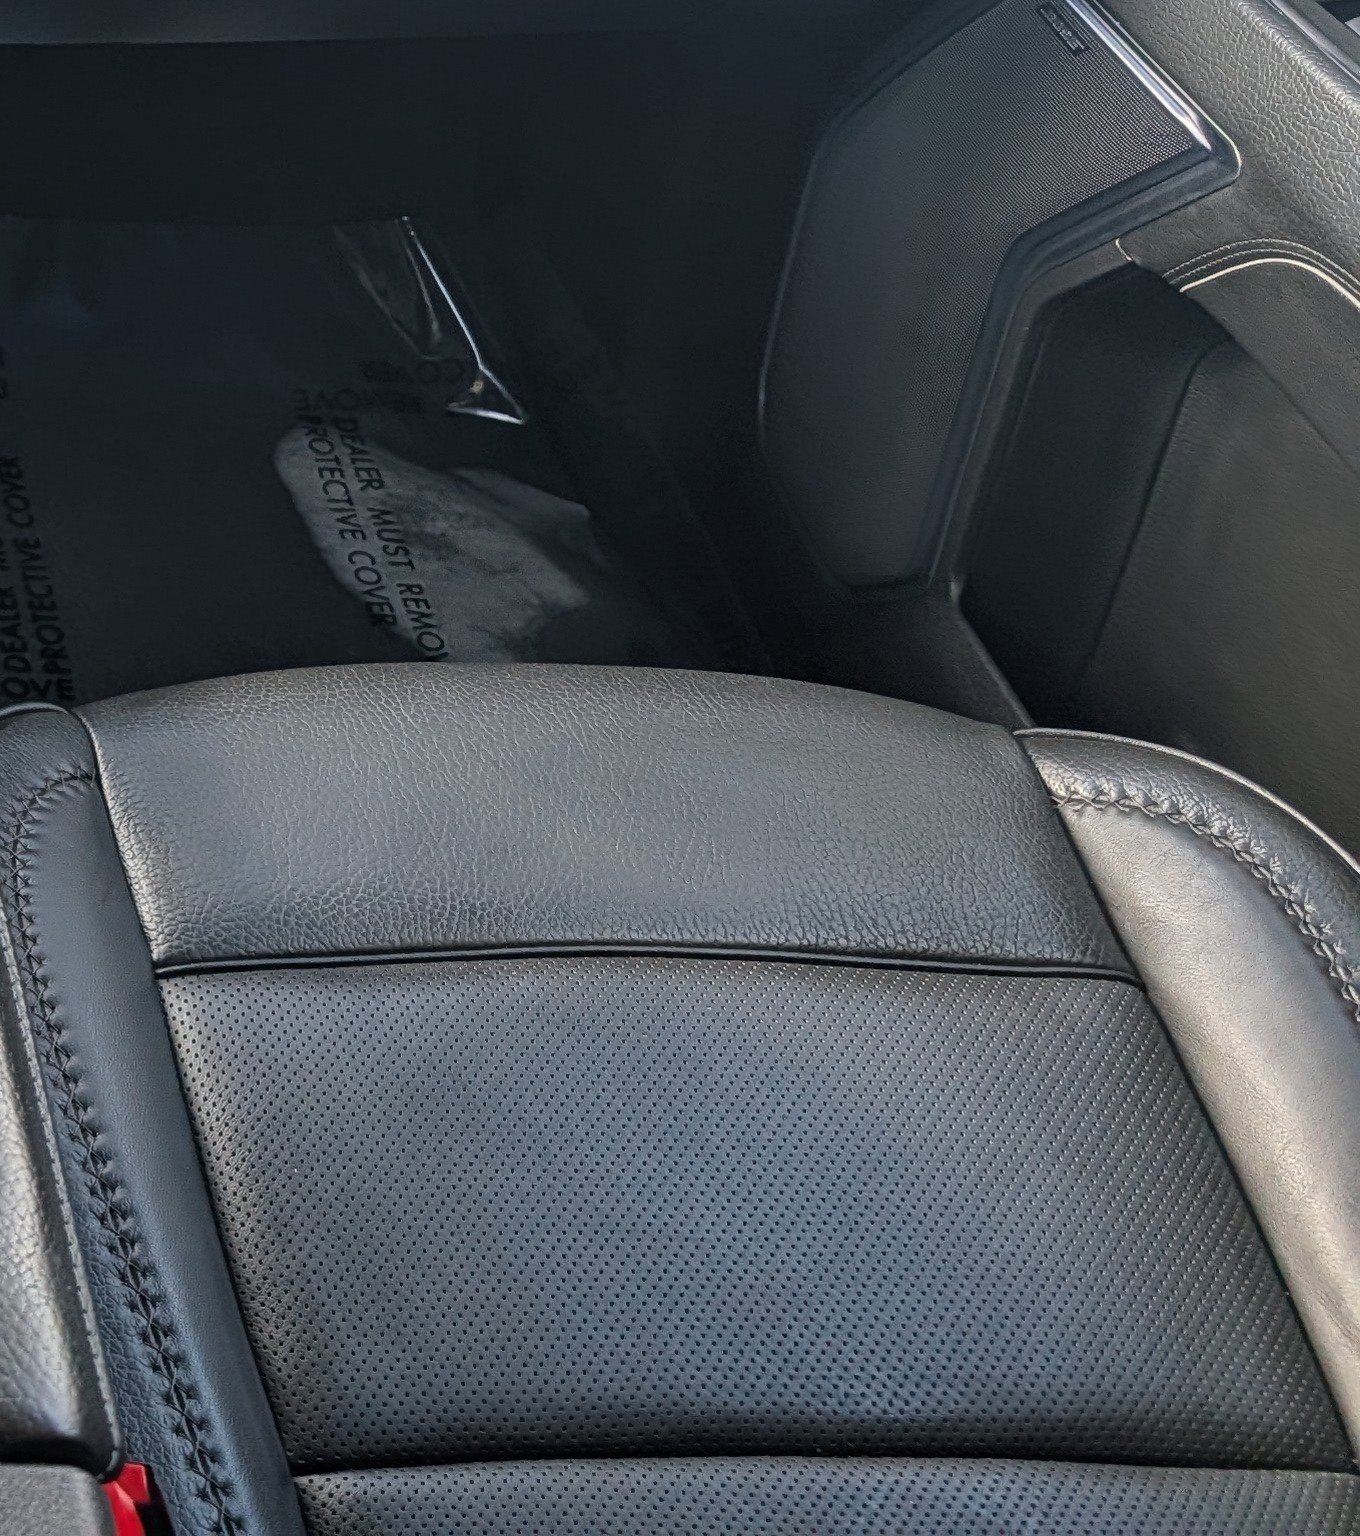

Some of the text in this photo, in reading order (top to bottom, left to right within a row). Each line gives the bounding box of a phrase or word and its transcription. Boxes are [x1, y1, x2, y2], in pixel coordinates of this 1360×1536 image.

[15, 536, 73, 675] PROTECTIVE
[298, 414, 397, 628] PROTECTIVE COVER
[332, 416, 449, 662] DEALER MUST REMO
